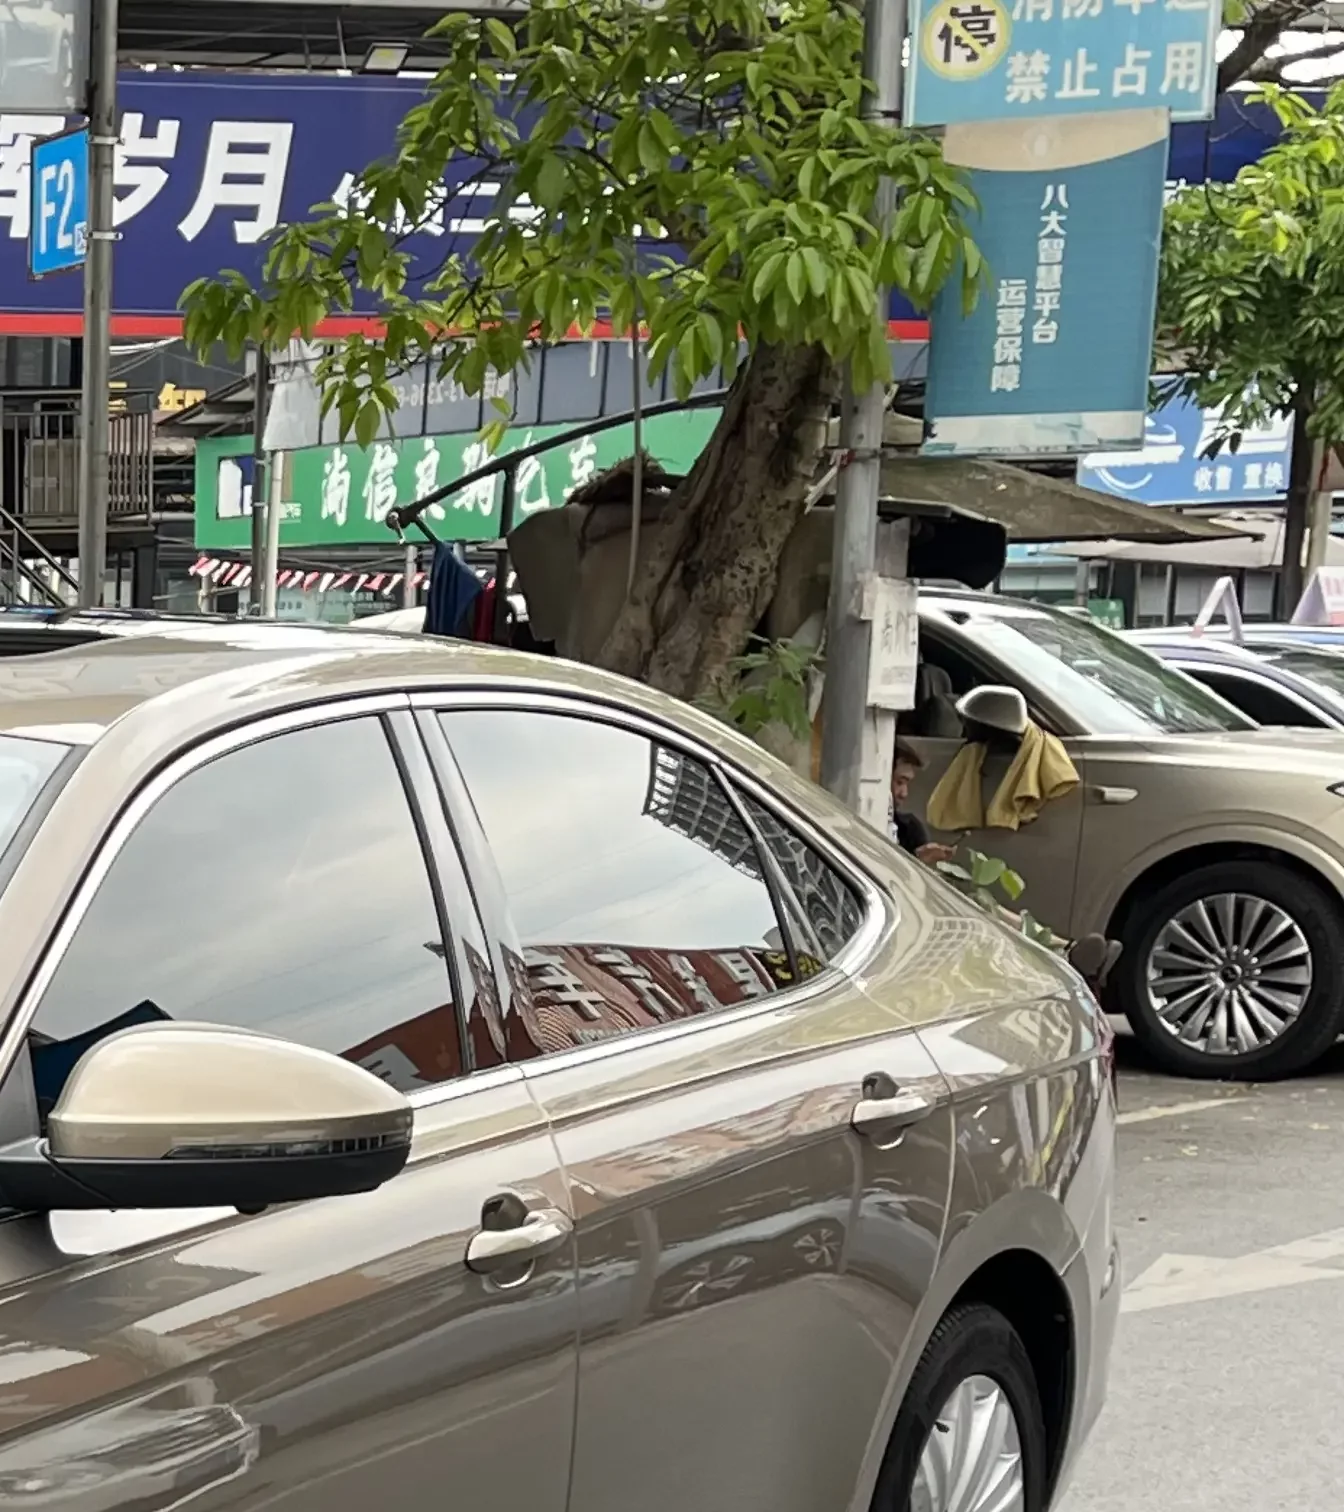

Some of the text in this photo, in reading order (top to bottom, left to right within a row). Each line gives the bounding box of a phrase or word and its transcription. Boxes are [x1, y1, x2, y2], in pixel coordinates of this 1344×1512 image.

[1005, 41, 1203, 103] 禁止占用
[1032, 184, 1069, 344] 八大智慧平台
[991, 279, 1027, 392] 运营保障
